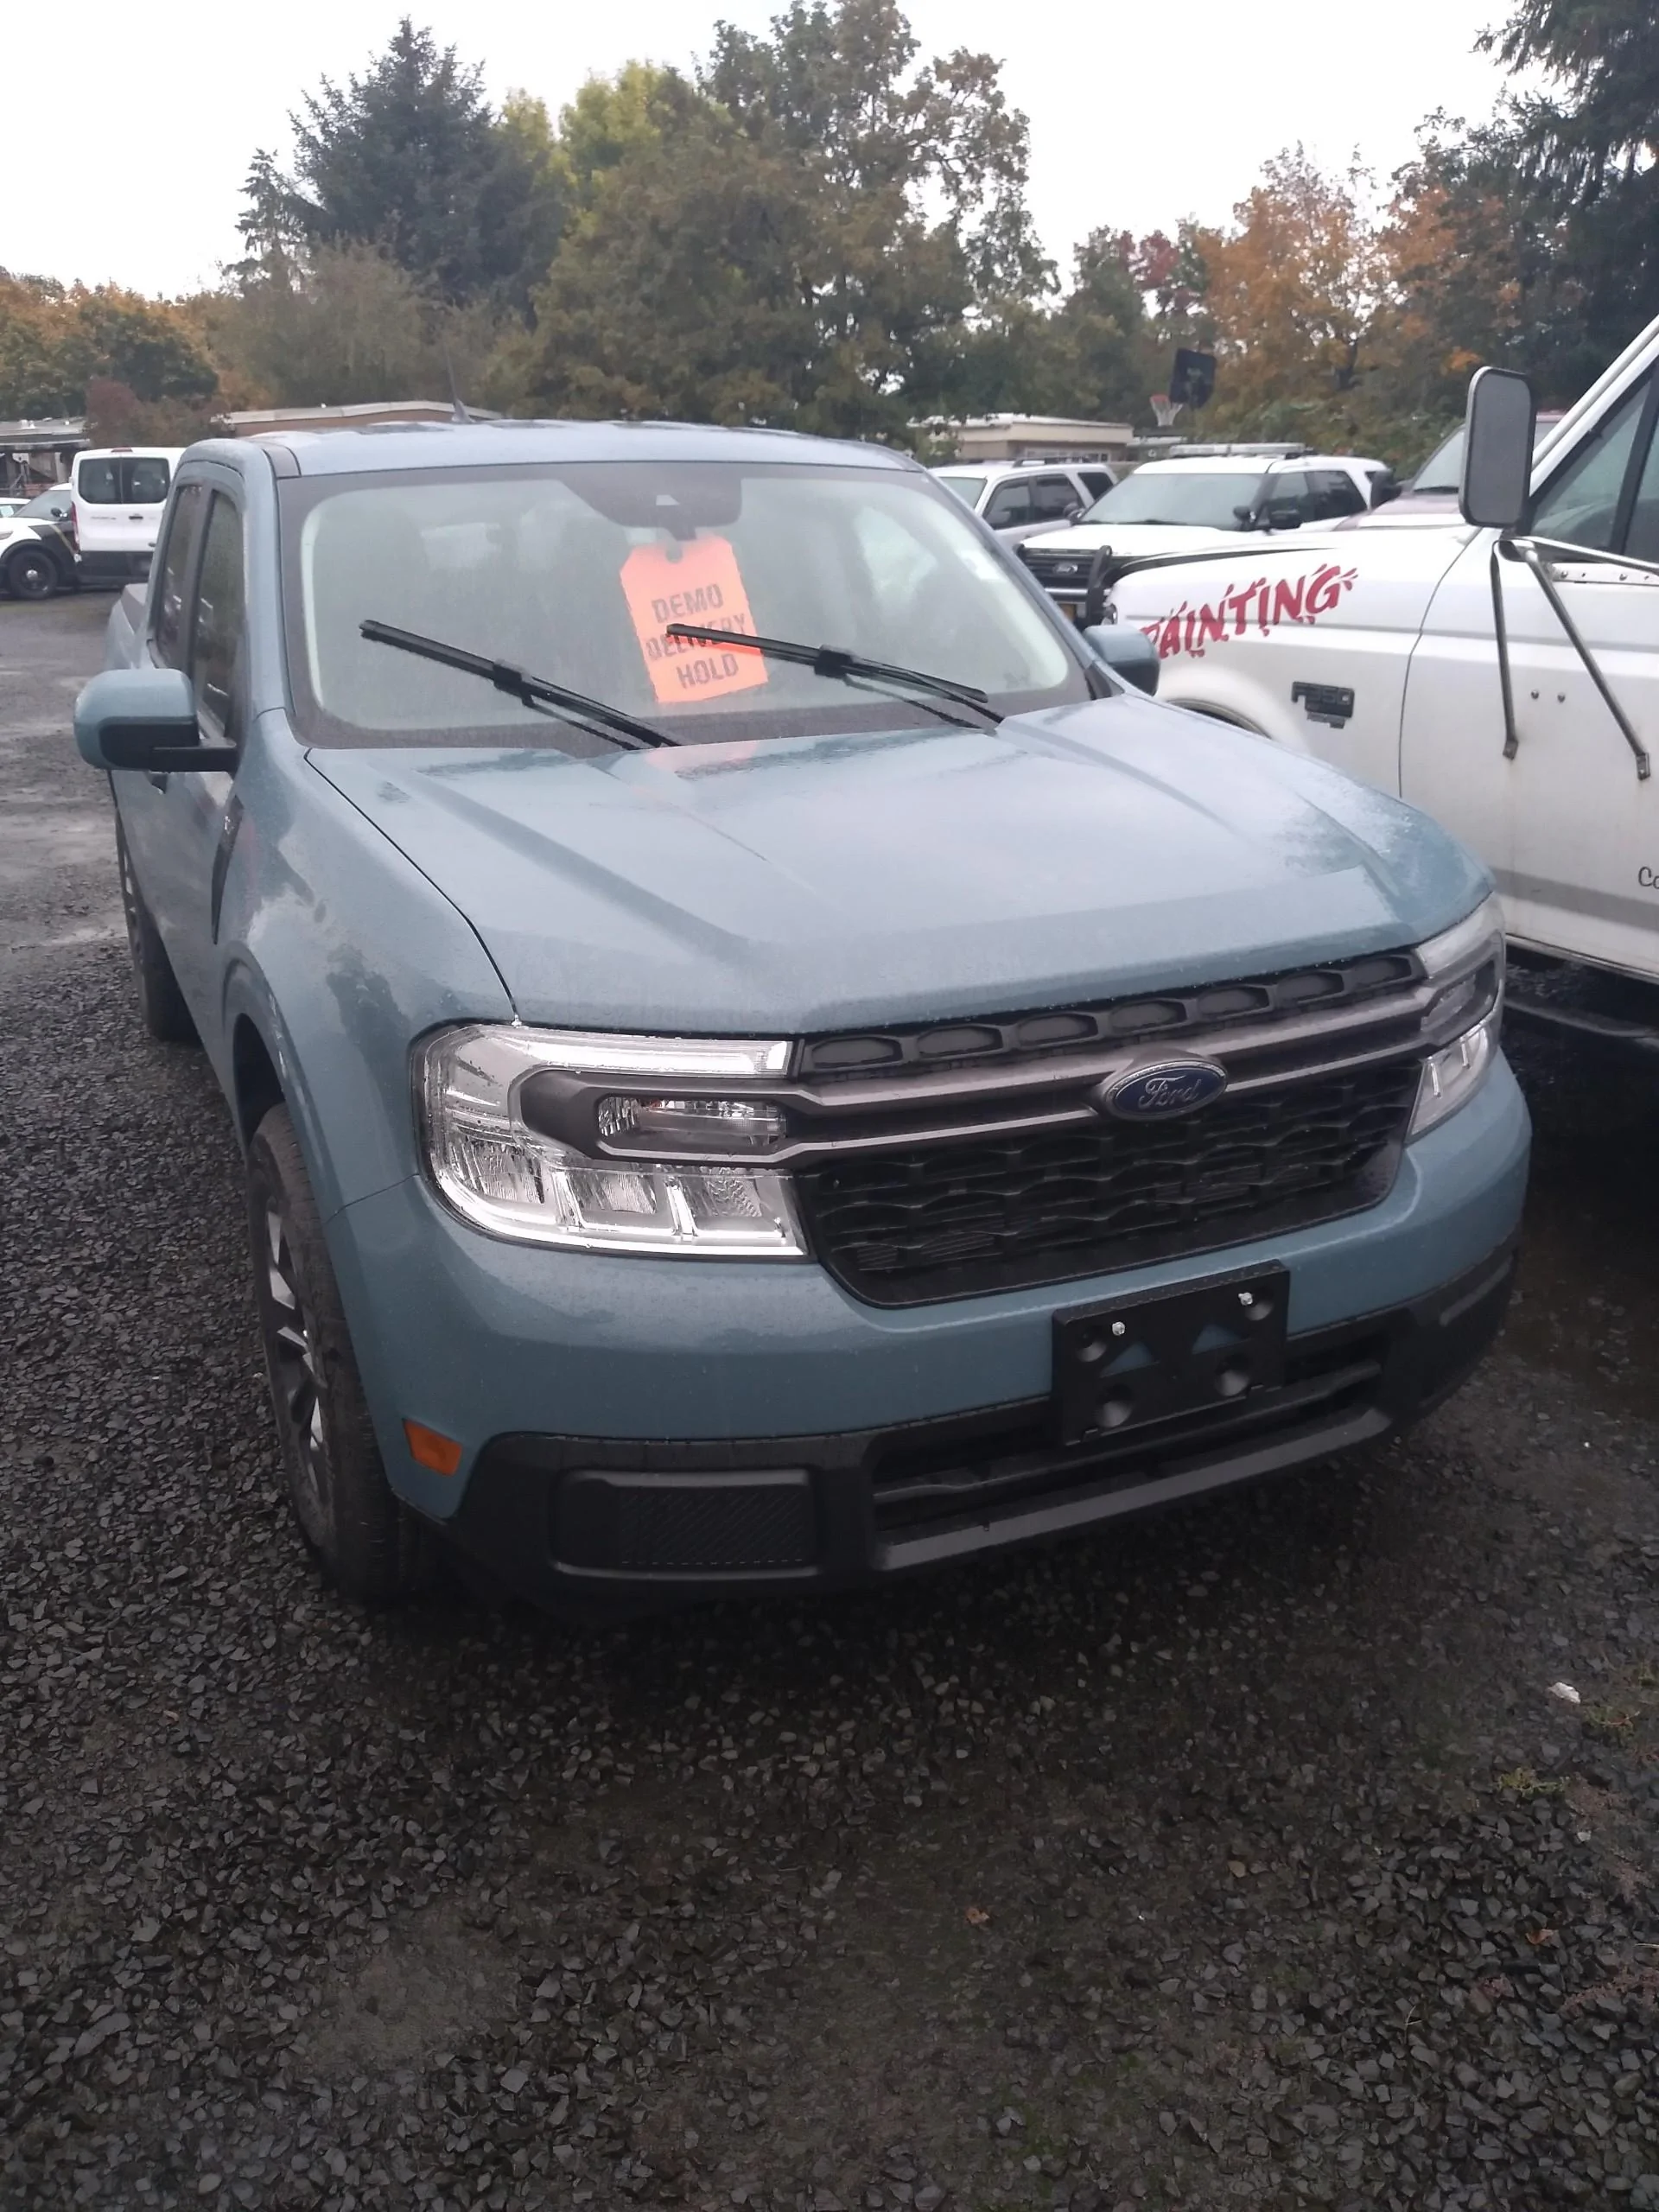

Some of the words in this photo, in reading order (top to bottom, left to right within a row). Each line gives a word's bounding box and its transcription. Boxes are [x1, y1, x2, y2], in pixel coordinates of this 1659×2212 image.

[652, 584, 724, 623] DEMO
[677, 653, 739, 688] HOLD
[1138, 1074, 1202, 1109] Ford
